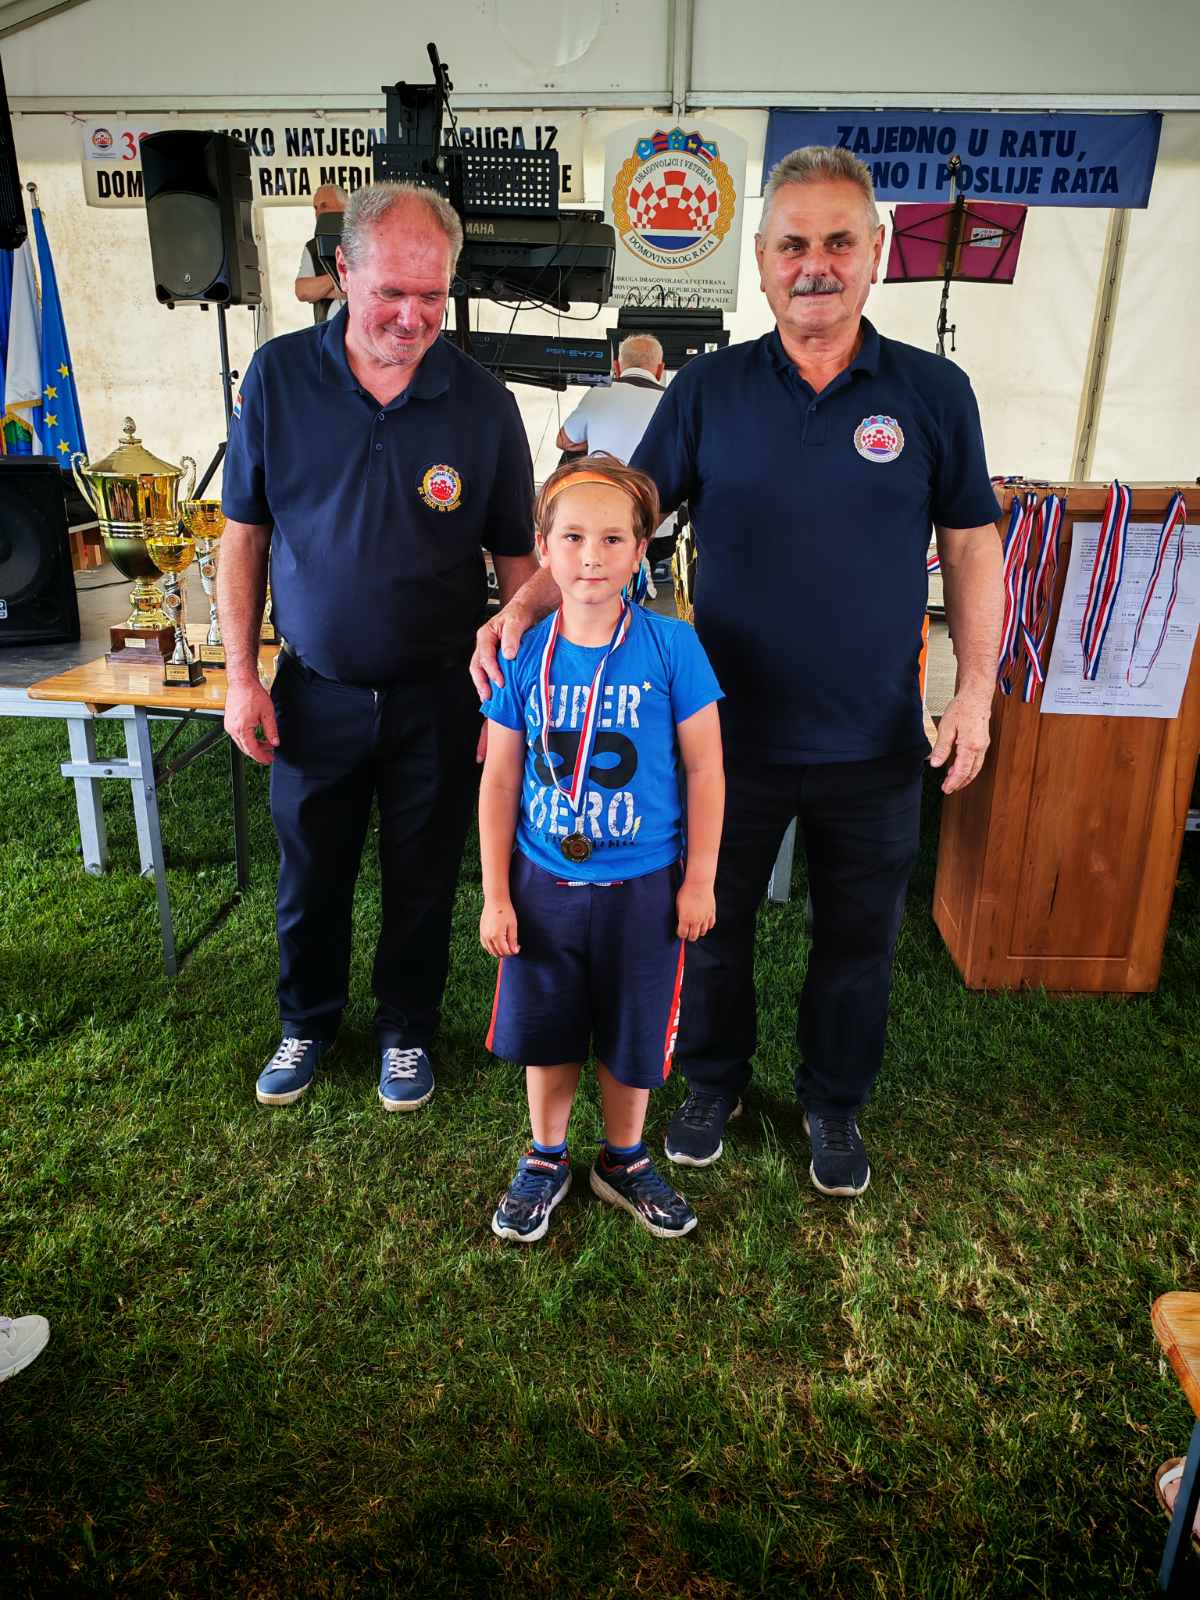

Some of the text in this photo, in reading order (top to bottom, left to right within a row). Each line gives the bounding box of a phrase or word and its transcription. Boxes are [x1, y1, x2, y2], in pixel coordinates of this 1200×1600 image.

[535, 126, 559, 151] IZ
[836, 125, 1087, 162] ZAJEDNO U RATU,
[96, 170, 145, 199] DOM
[259, 167, 312, 196] RATA
[868, 161, 1120, 195] NO I POSLIJE RATA
[465, 223, 496, 235] MAHA
[628, 236, 715, 265] DOMOVINSKOG RATA
[528, 684, 642, 729] SUPER
